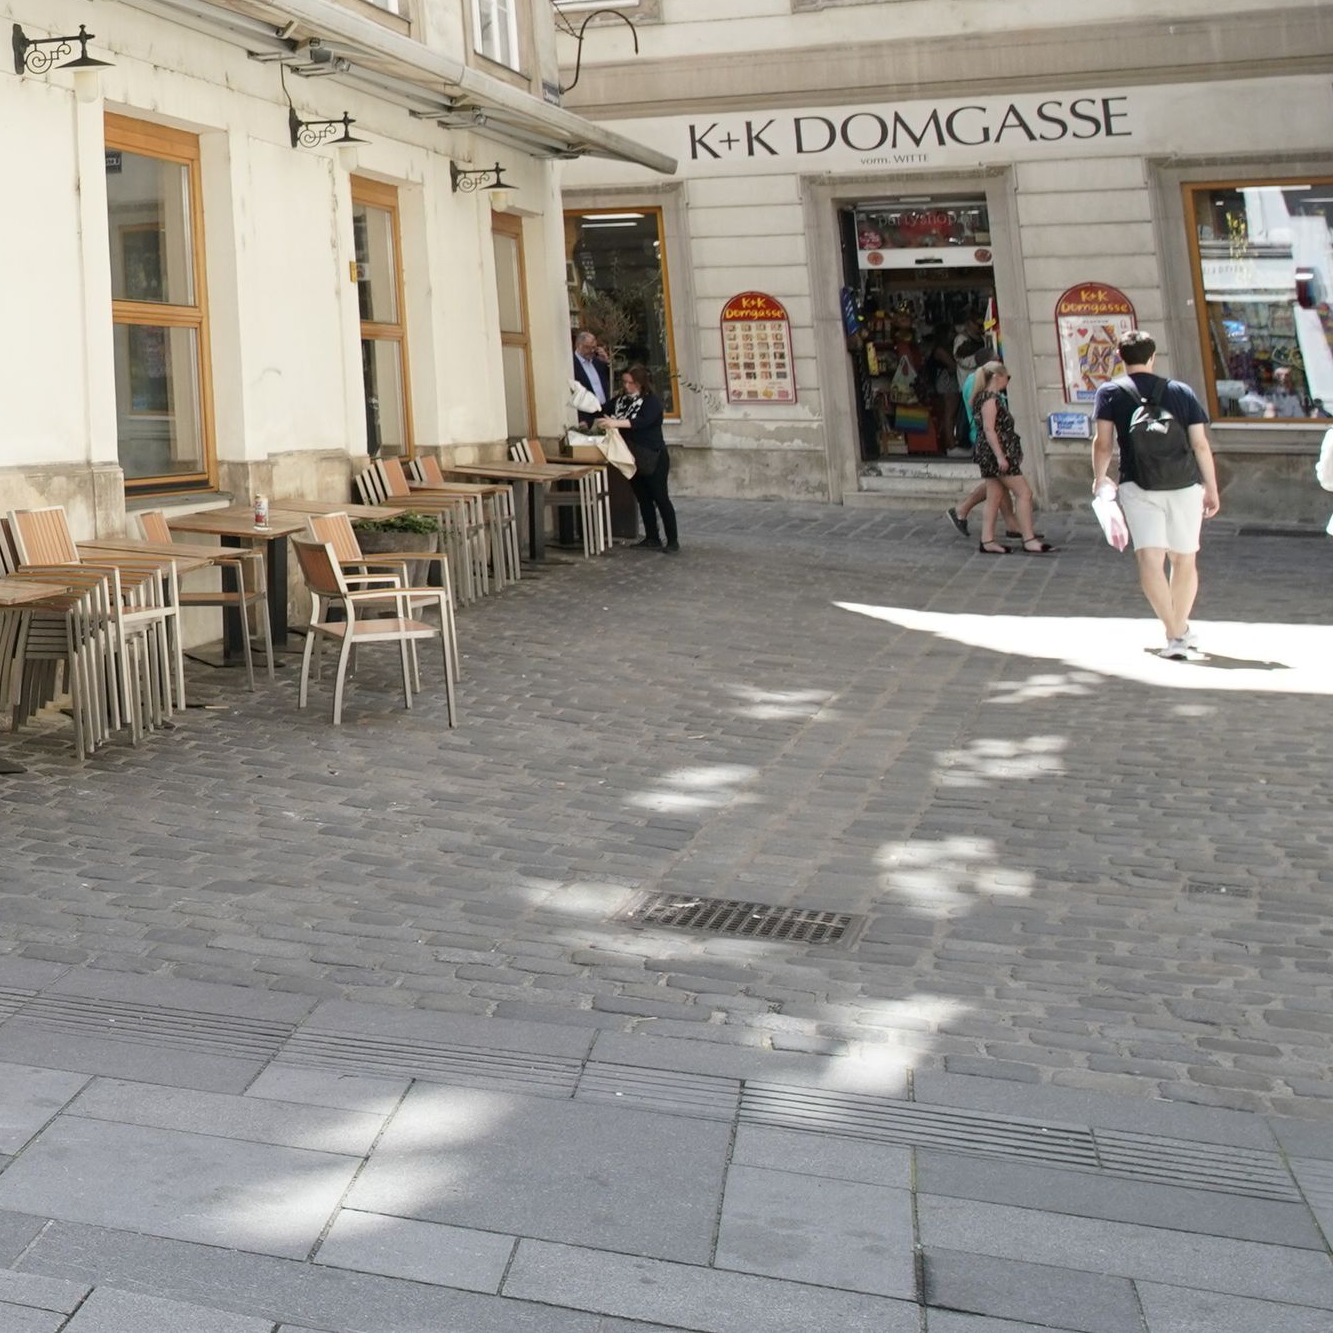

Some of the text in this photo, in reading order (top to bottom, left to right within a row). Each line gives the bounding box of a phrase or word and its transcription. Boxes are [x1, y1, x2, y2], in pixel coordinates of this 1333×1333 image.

[688, 96, 1133, 160] K+K DOMGASSE
[893, 153, 930, 164] WITTE
[1060, 302, 1129, 314] Domgasse
[725, 308, 785, 321] Domgasse
